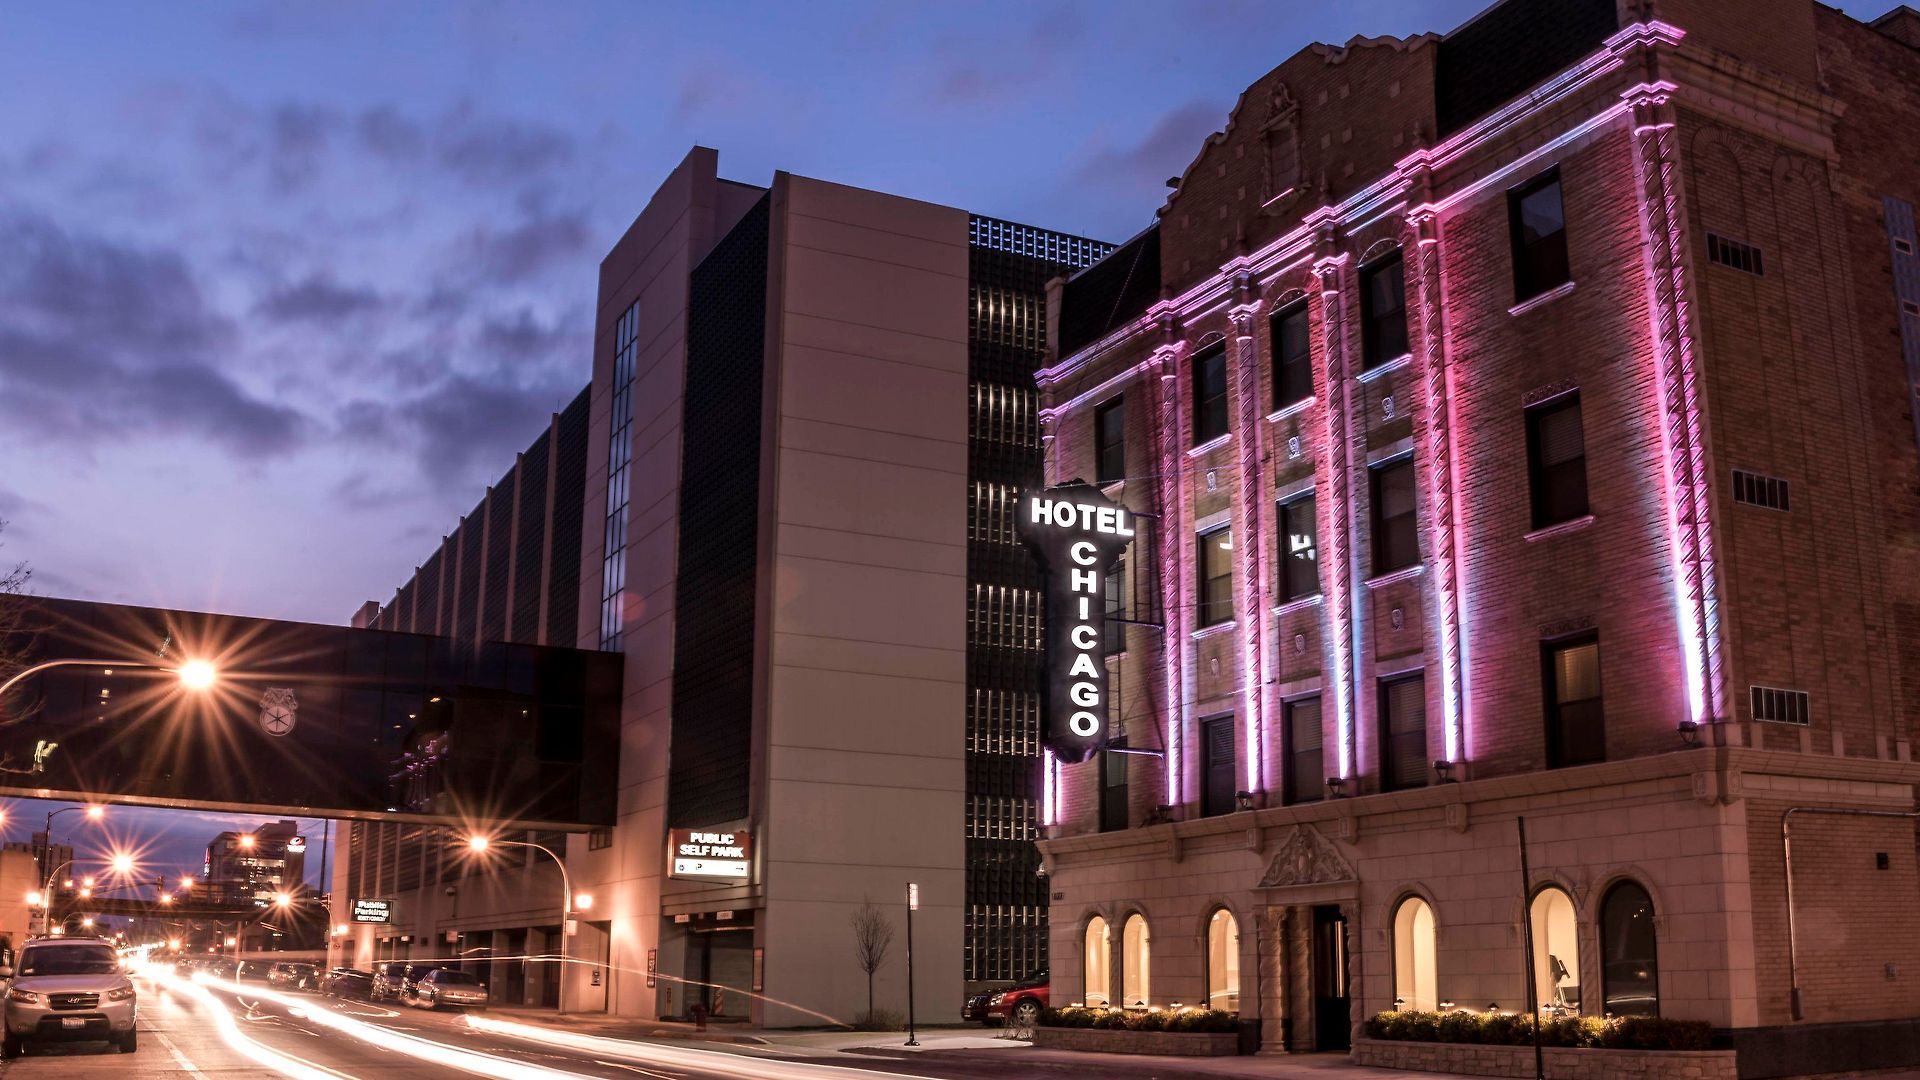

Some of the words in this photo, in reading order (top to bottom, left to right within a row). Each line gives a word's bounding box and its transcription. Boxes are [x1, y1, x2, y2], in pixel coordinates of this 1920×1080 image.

[1031, 497, 1134, 537] HOTEL
[1069, 541, 1099, 737] CHICAGO
[690, 832, 734, 844] PUBLIC
[680, 844, 710, 856] SELF
[711, 845, 744, 858] PARK
[358, 901, 387, 909] Public
[355, 908, 389, 917] Parking
